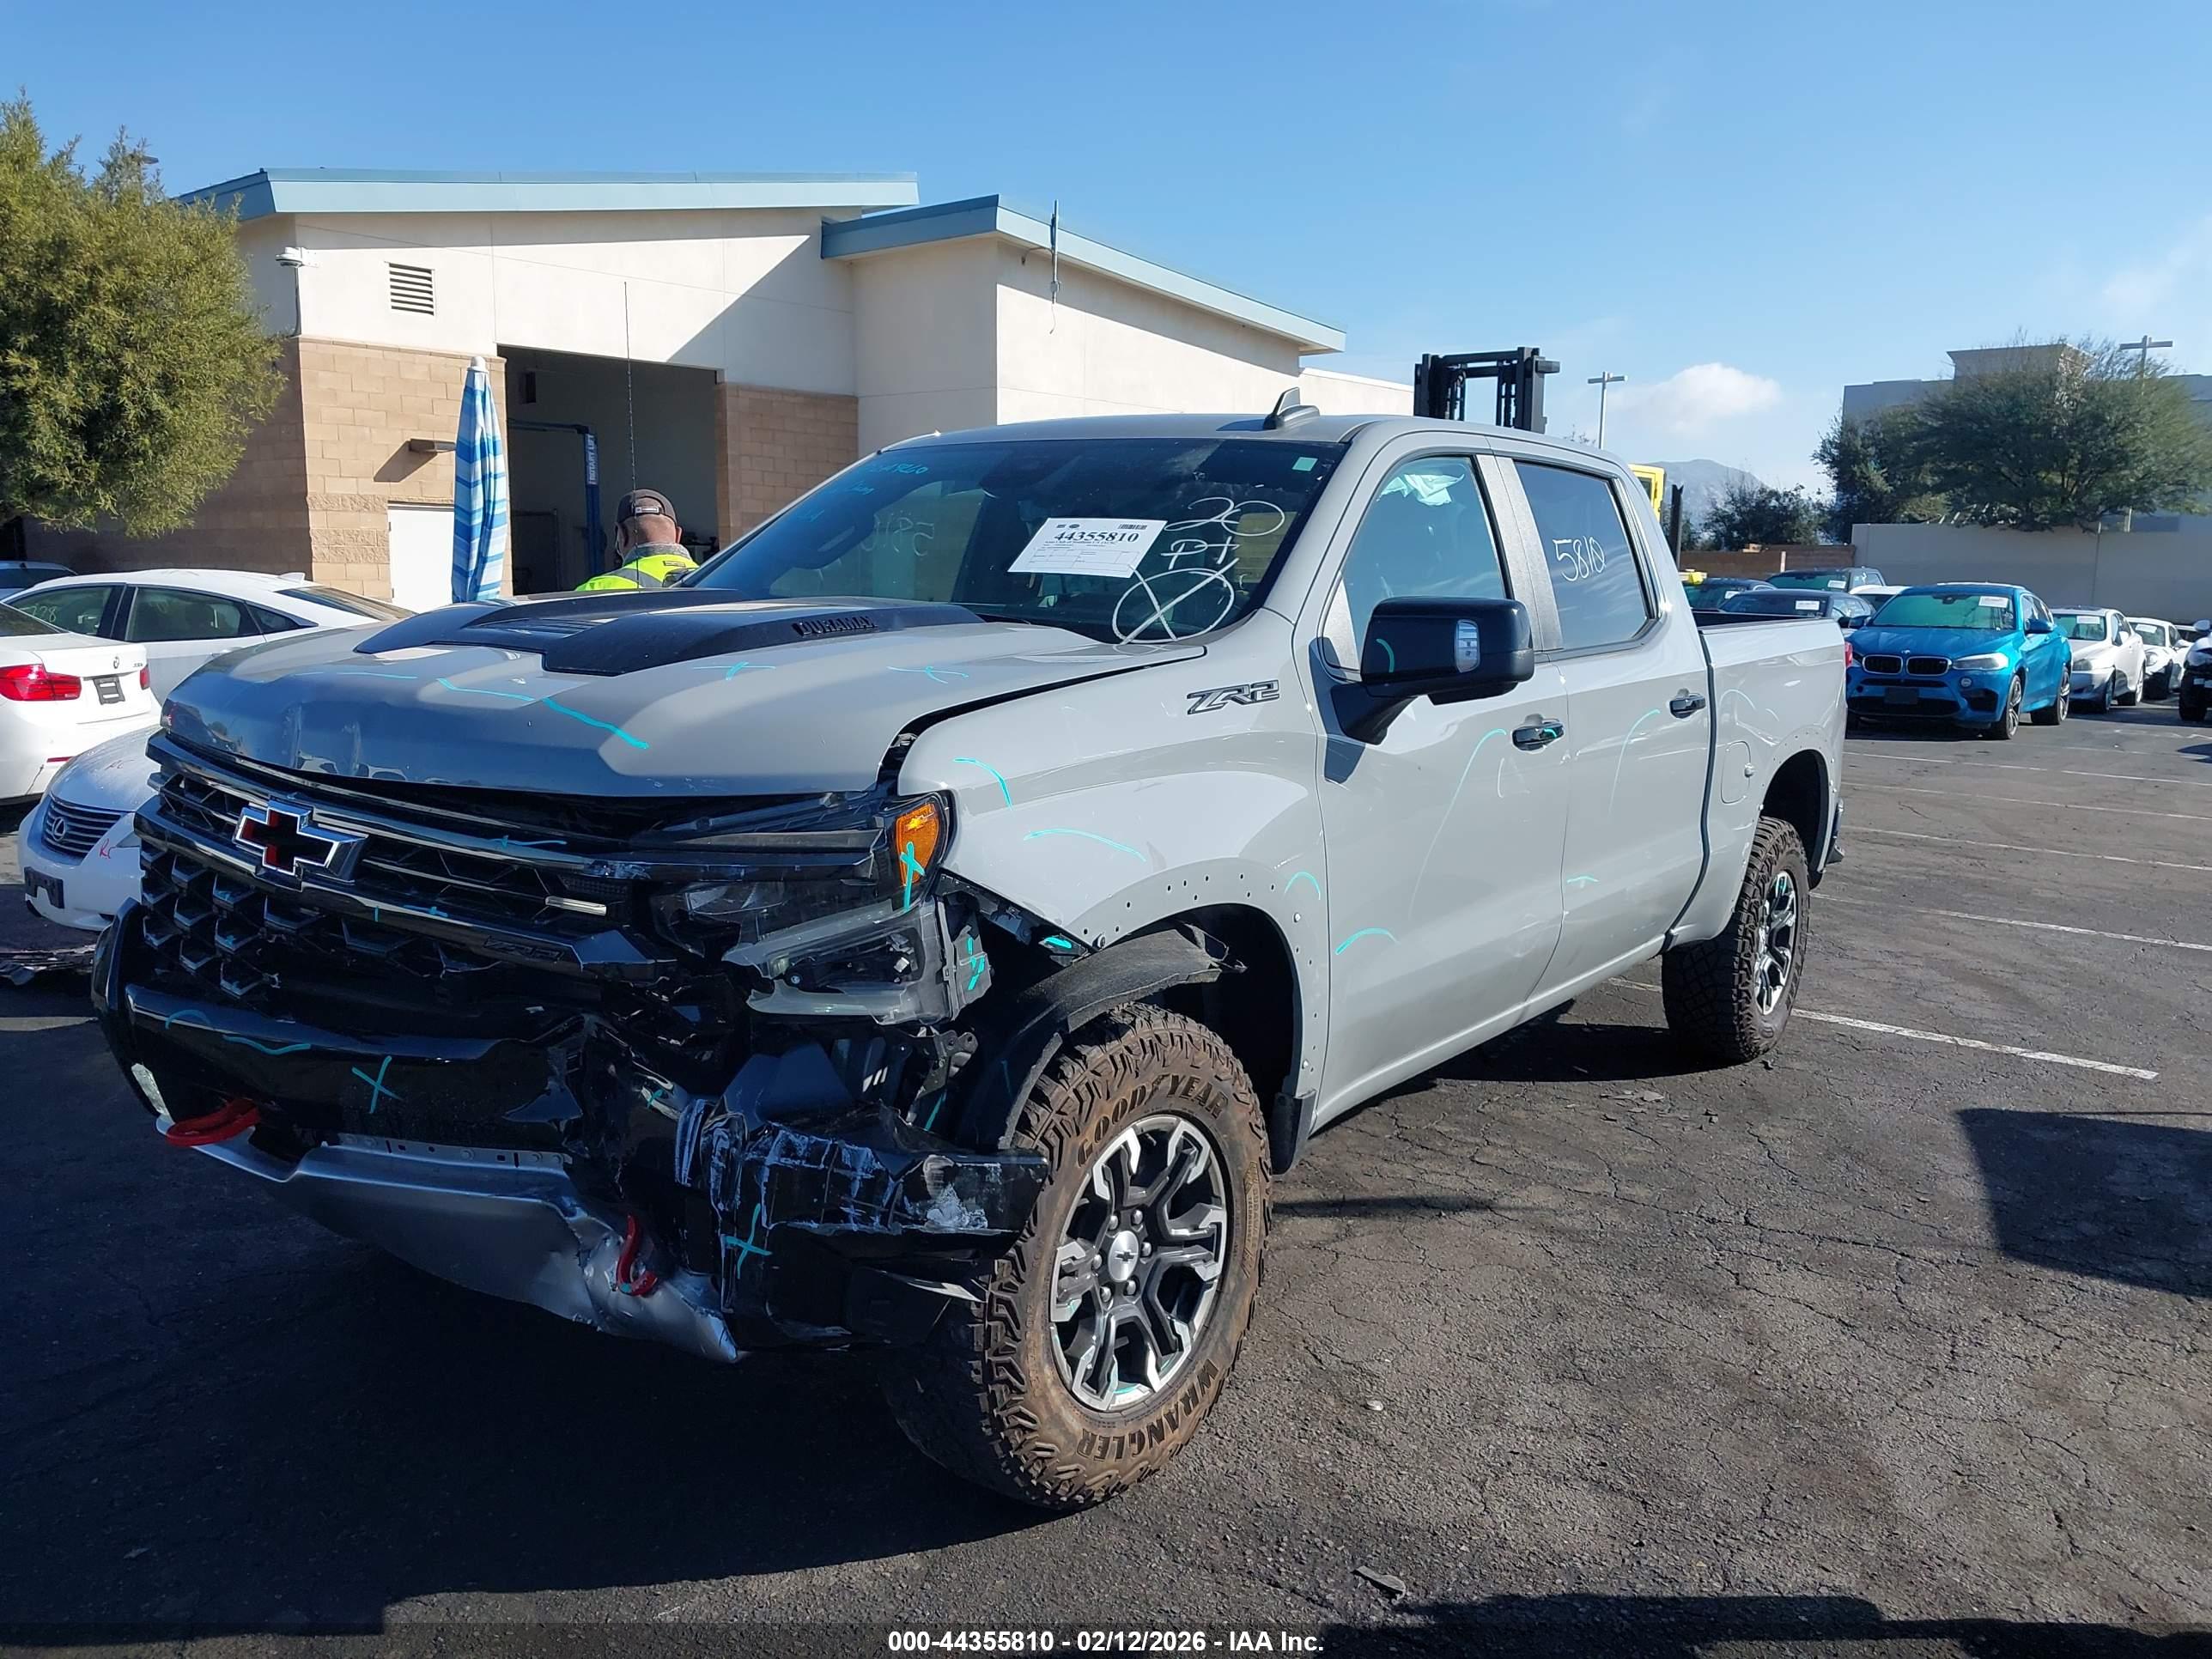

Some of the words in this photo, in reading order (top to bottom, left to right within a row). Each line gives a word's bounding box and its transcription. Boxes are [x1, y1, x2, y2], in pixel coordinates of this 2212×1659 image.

[1054, 531, 1139, 543] 44355810
[1164, 497, 1285, 536] 20
[1553, 535, 1607, 581] 5810
[1187, 679, 1280, 715] ZR2
[1077, 1073, 1230, 1168] GOODYEAR
[1077, 1358, 1219, 1462] WRANGLER
